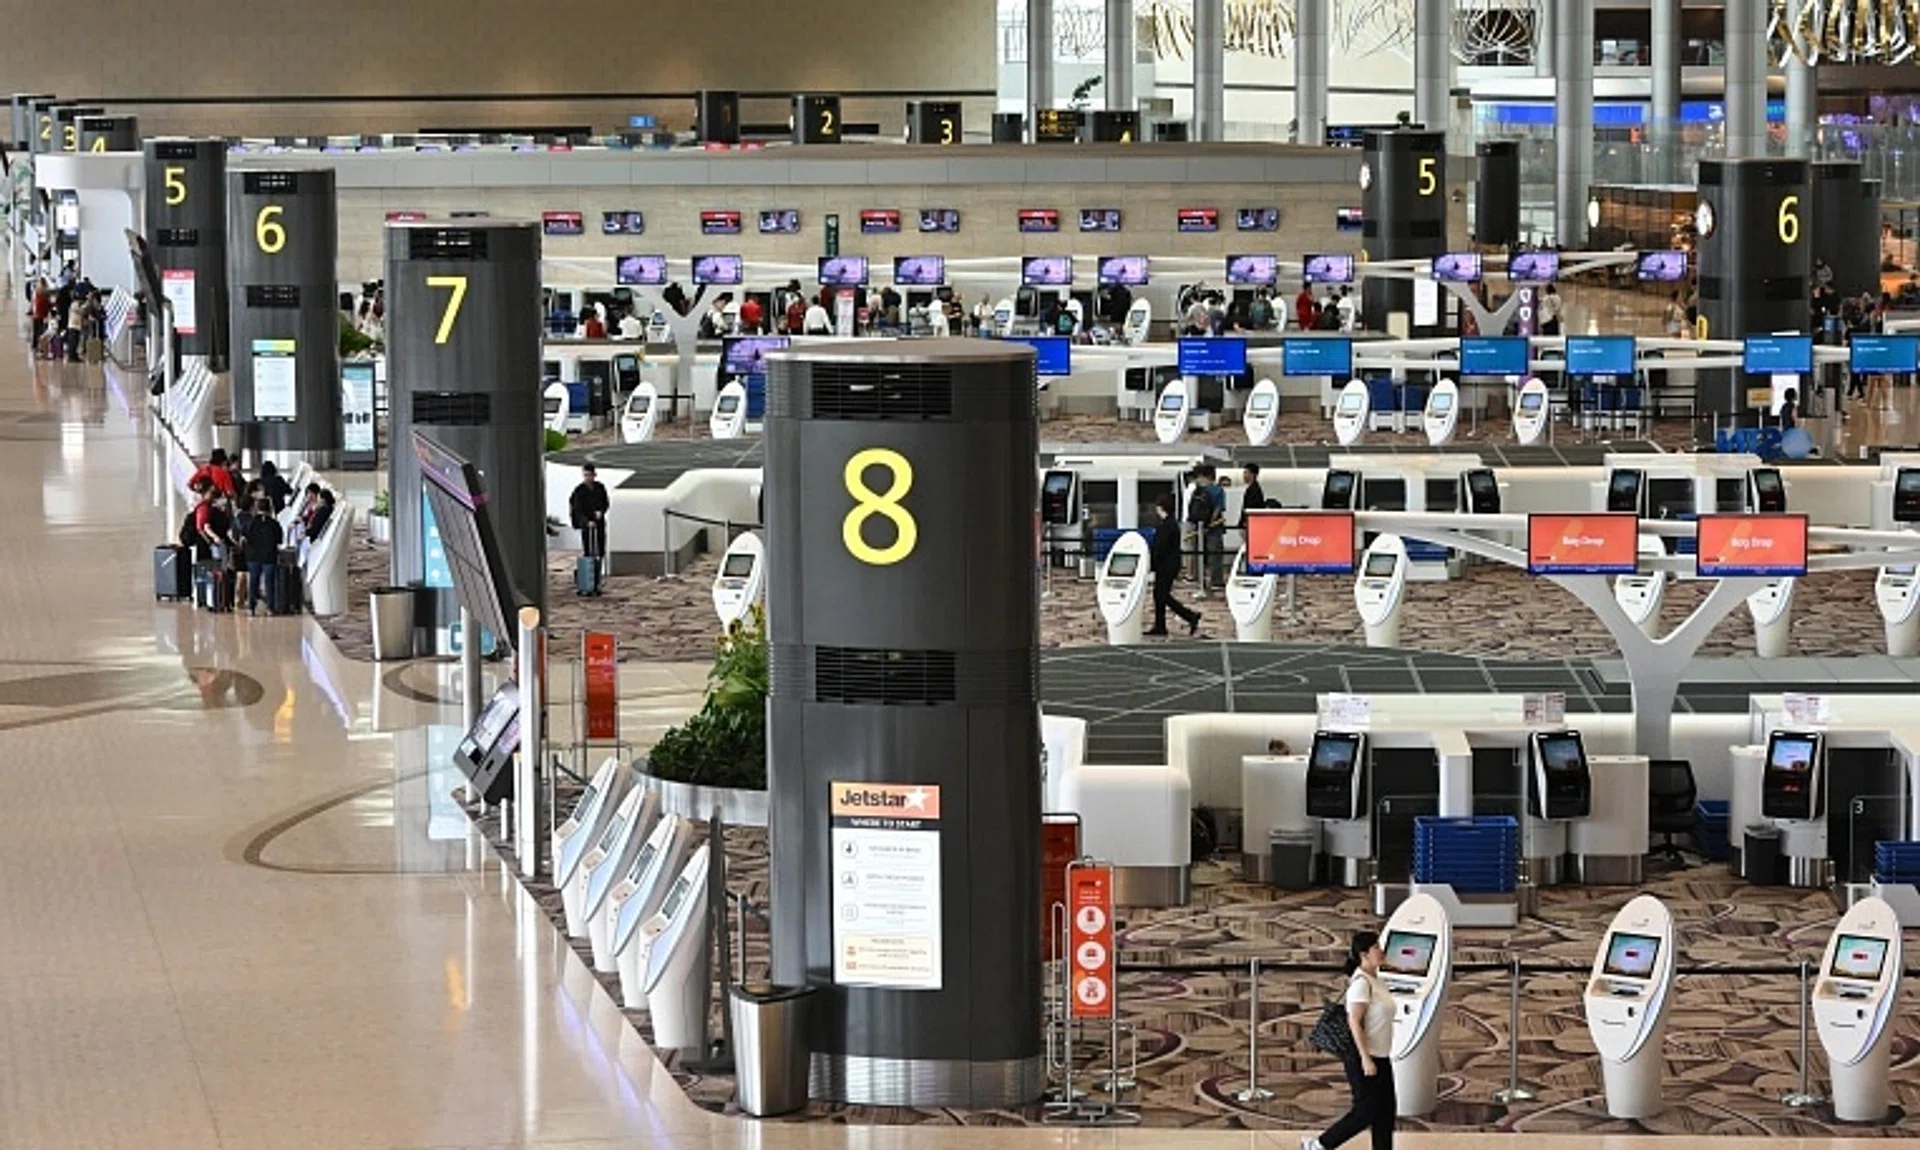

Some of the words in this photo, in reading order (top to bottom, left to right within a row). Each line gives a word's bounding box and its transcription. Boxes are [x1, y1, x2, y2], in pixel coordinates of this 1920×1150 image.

[41, 115, 52, 139] 2
[821, 110, 833, 134] 2
[941, 119, 953, 145] 3
[63, 125, 76, 151] 3
[165, 167, 186, 205] 5
[1419, 158, 1436, 195] 5
[256, 205, 286, 254] 6
[1779, 196, 1799, 243] 6
[425, 276, 468, 344] 7
[843, 448, 917, 566] 8
[1279, 535, 1298, 547] Bag
[1298, 535, 1321, 547] Drop
[1562, 536, 1580, 548] Bag
[1731, 537, 1750, 550] Bag
[1751, 537, 1773, 549] Drop
[840, 790, 907, 807] Jetstar
[1854, 800, 1864, 814] 3
